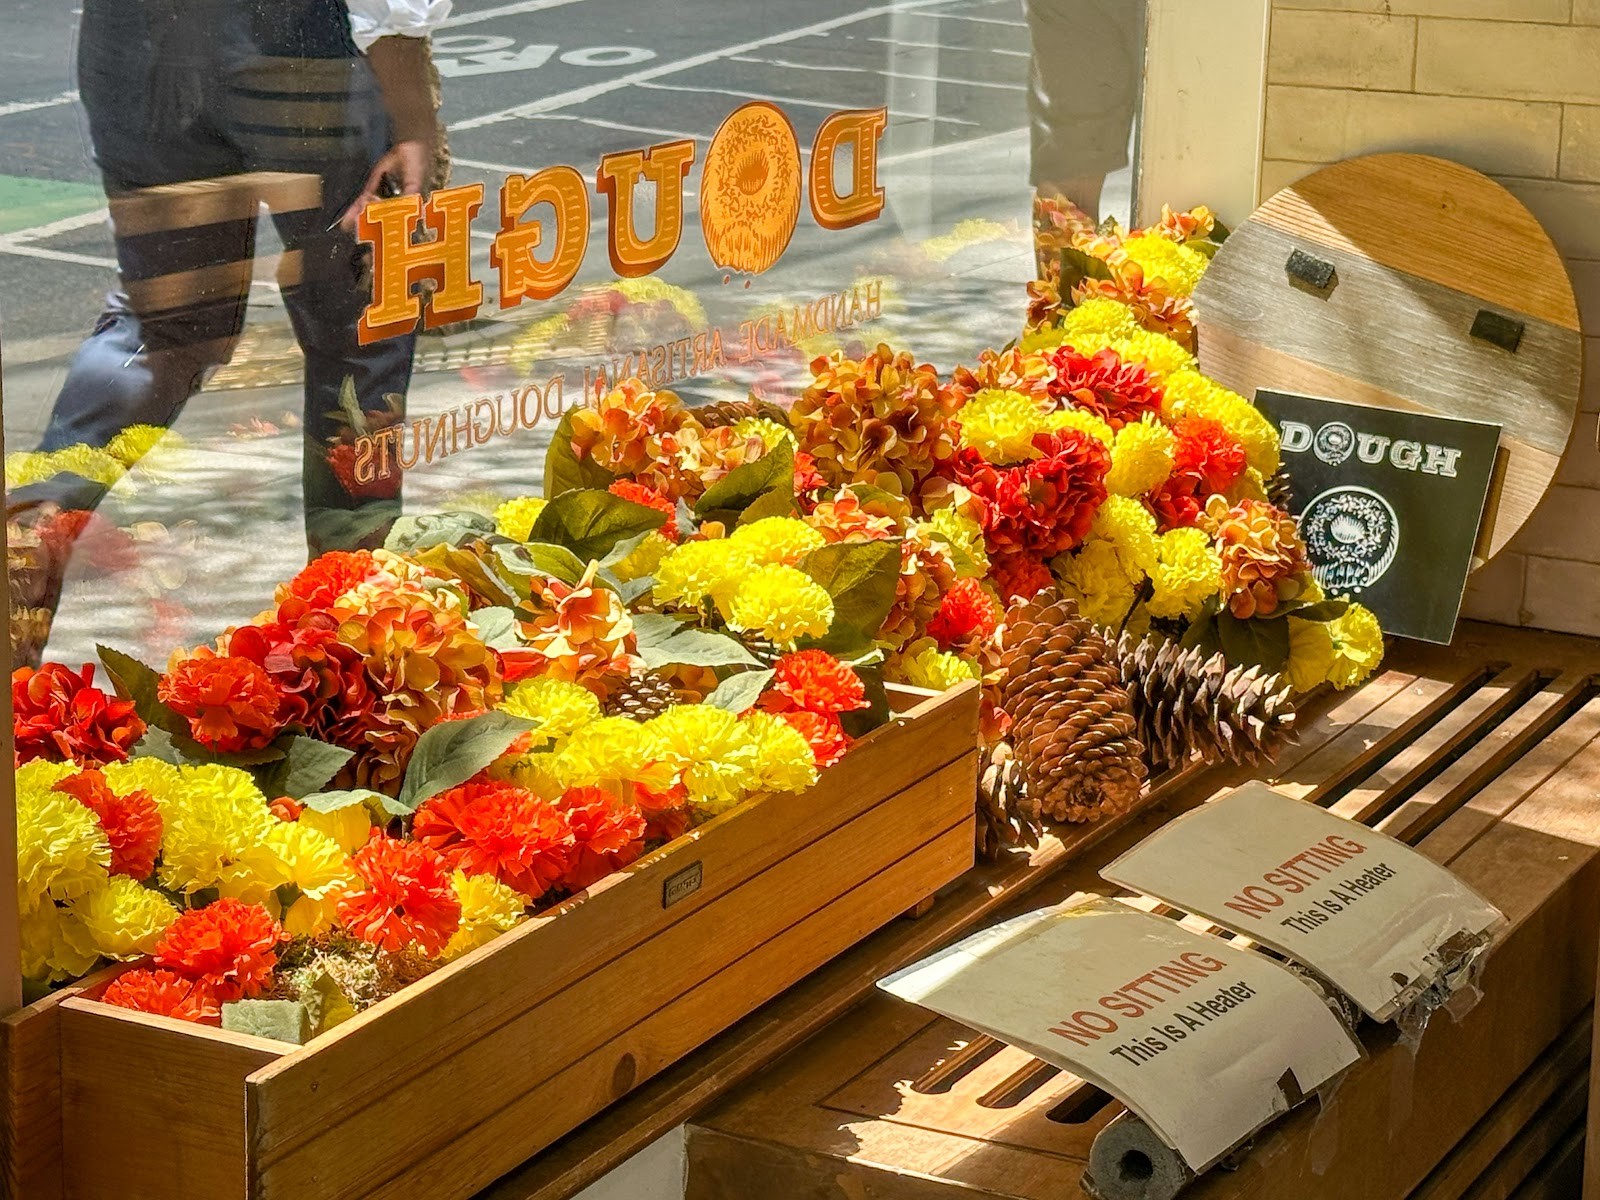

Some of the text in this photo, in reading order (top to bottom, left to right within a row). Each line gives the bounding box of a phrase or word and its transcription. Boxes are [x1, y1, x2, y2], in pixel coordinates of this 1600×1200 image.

[1280, 420, 1462, 477] DOUGH
[1224, 835, 1367, 920] NO SITTING
[1280, 862, 1396, 934] This Is A Heater
[1047, 952, 1227, 1047] NO SITTING
[1109, 981, 1256, 1066] This Is A Heater
